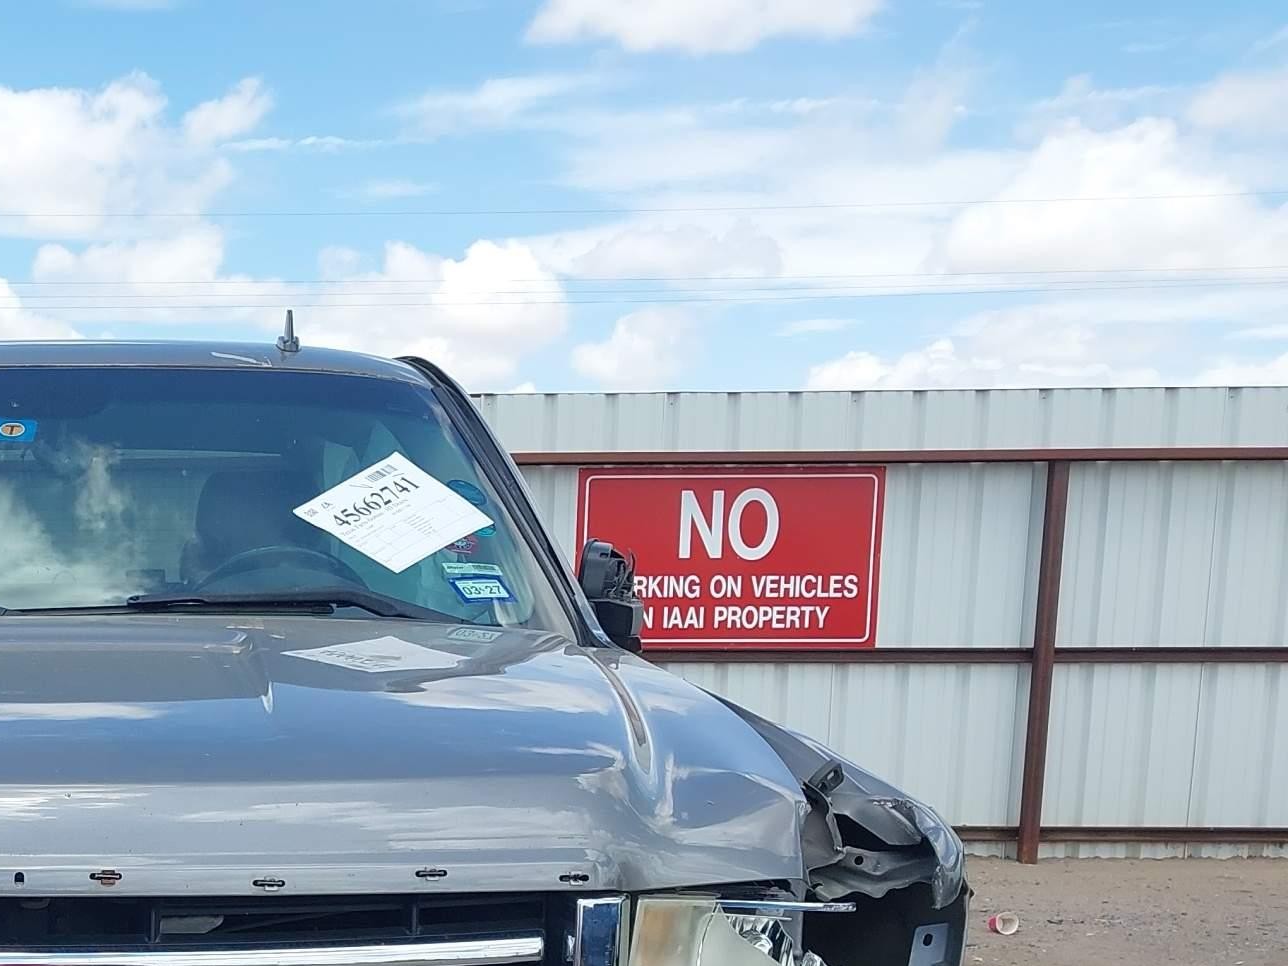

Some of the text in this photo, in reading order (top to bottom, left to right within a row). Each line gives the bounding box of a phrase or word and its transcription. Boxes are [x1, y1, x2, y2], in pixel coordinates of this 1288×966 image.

[333, 477, 420, 526] 45662741
[678, 487, 780, 561] NO
[633, 574, 858, 599] RKING ON VEHICLES
[662, 606, 705, 629] IAAI
[713, 605, 830, 629] PROPERTY
